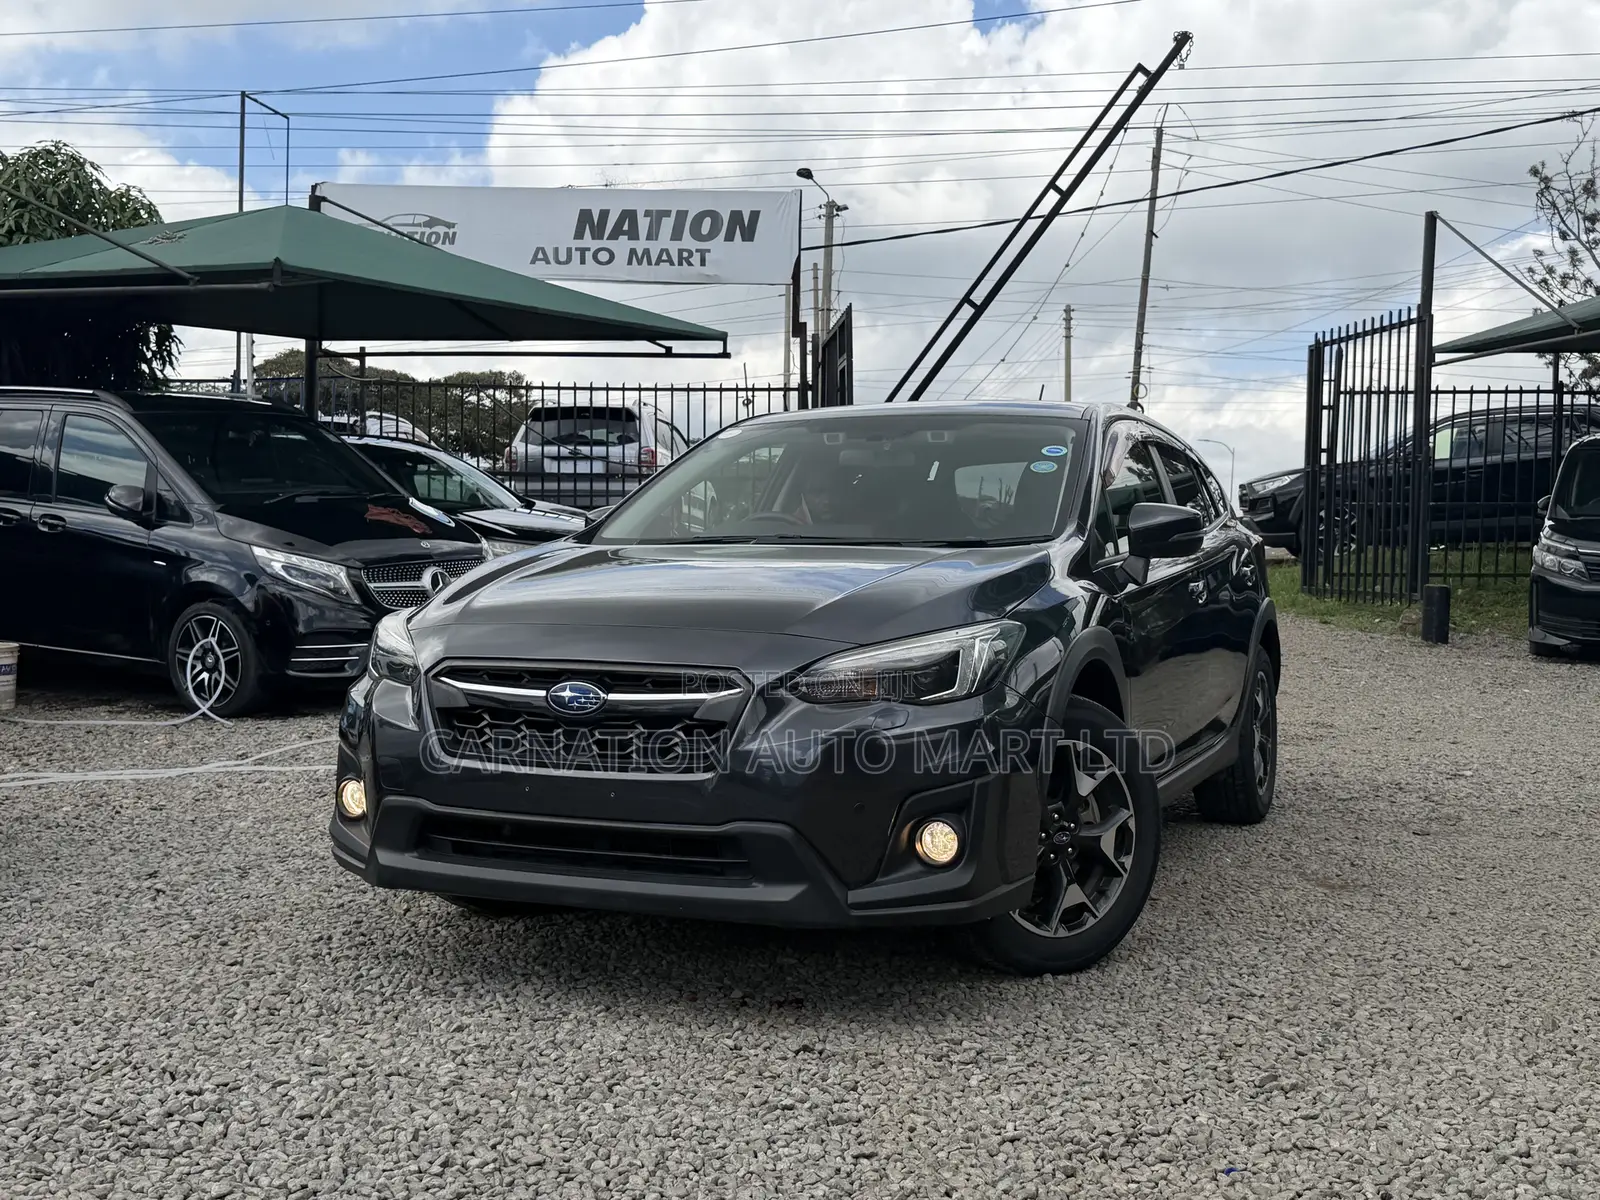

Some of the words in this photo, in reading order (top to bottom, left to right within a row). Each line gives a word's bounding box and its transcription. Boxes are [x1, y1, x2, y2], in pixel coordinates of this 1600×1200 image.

[573, 208, 762, 243] NATION
[529, 246, 616, 266] AUTO
[626, 247, 712, 267] MART
